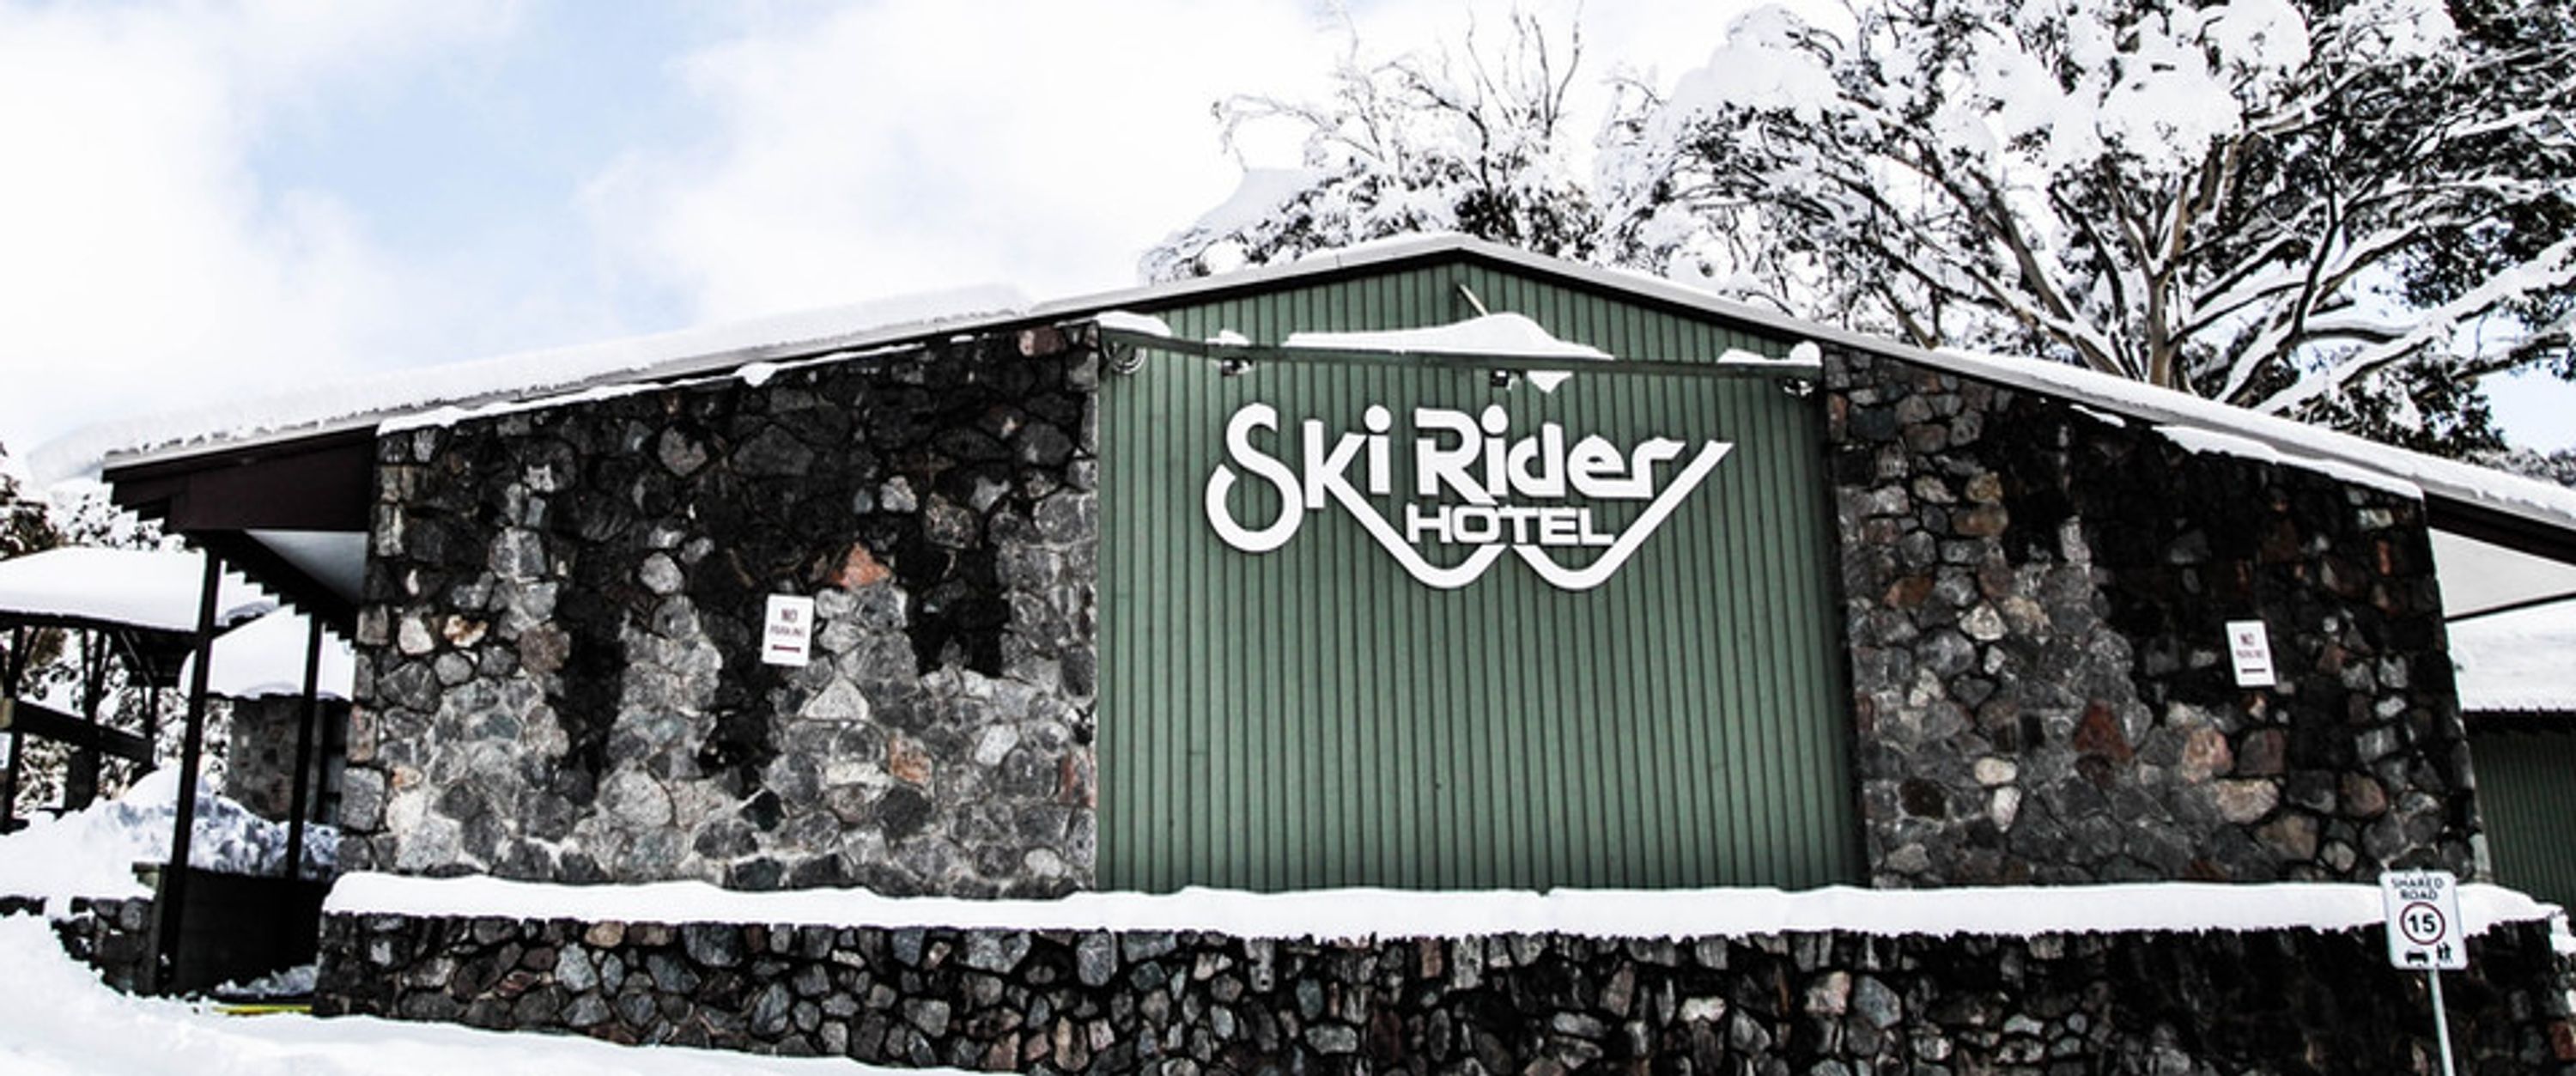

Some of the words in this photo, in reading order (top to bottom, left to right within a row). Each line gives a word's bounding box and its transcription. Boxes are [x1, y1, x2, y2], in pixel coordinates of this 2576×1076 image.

[1206, 403, 1393, 552] Ski
[1415, 404, 1686, 505] Rider
[1406, 503, 1615, 545] HOTEL
[781, 608, 799, 623] NO
[2391, 877, 2445, 890] SHARED
[2400, 889, 2438, 901] ROAD
[2408, 913, 2436, 933] 15
